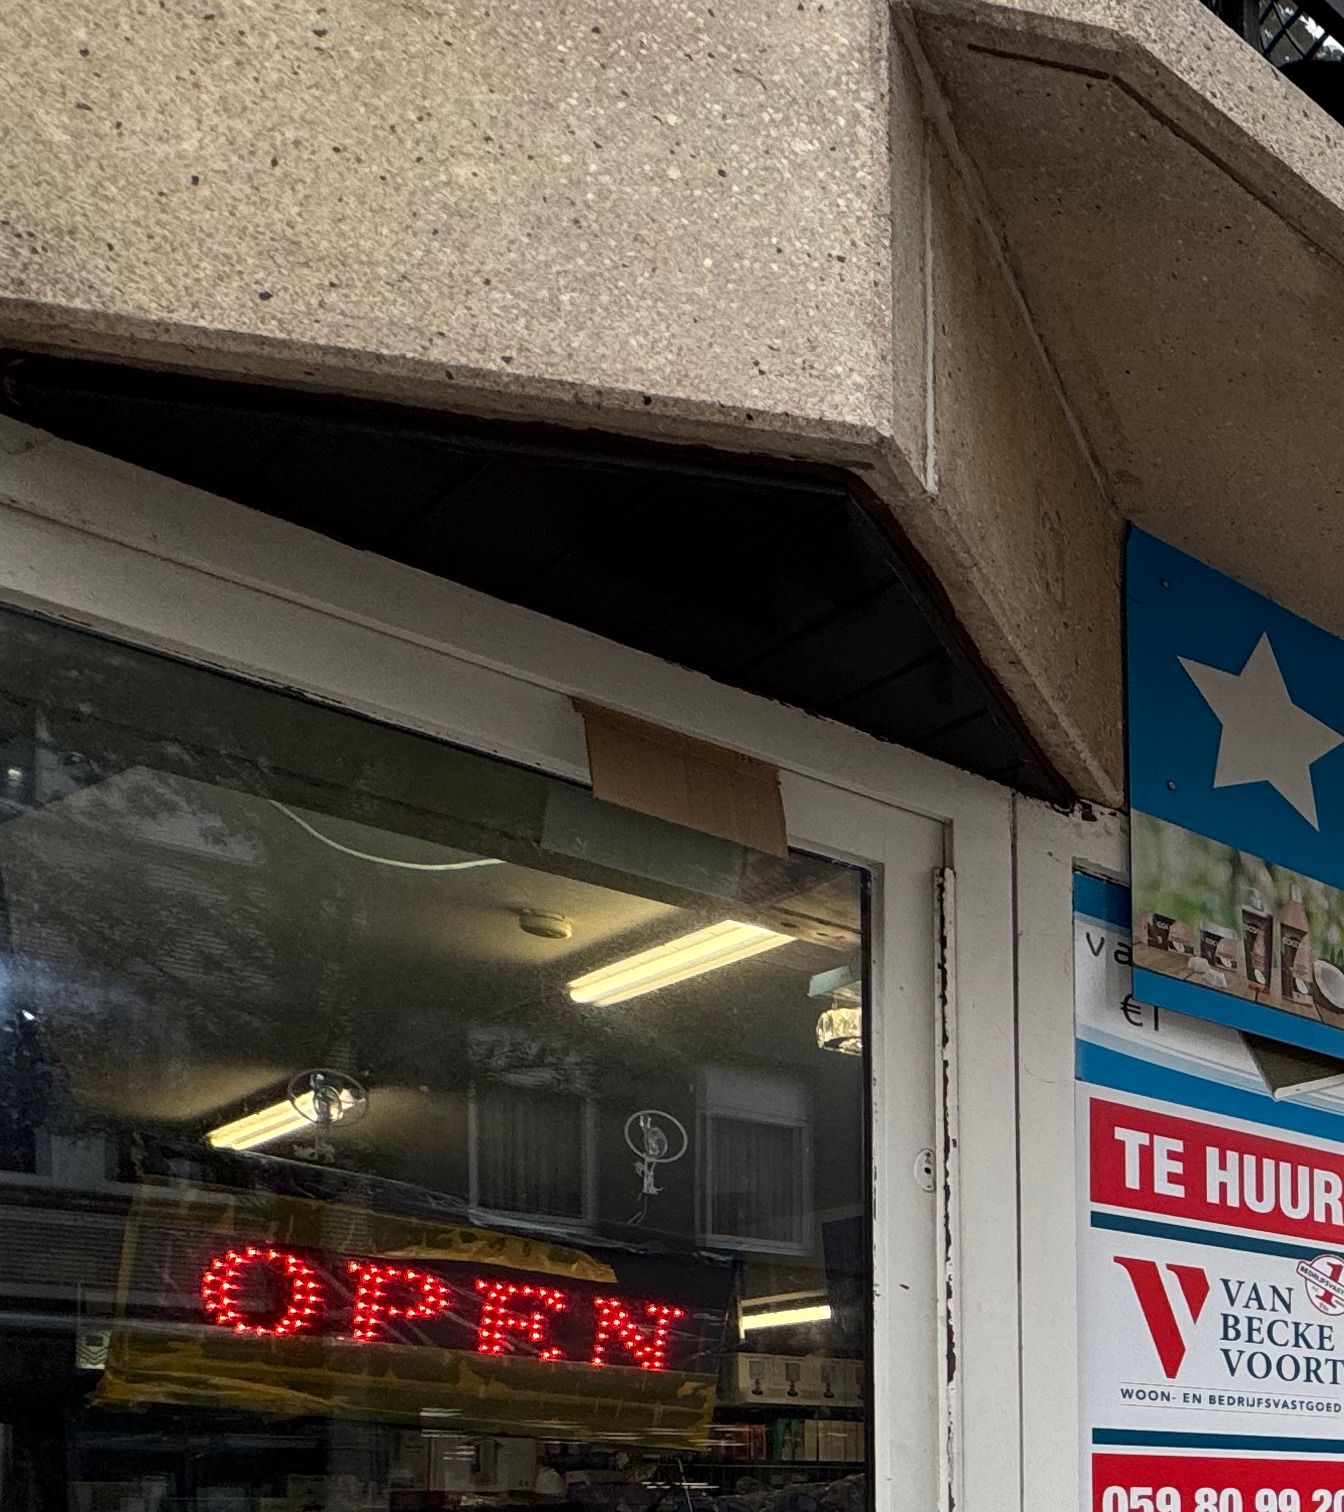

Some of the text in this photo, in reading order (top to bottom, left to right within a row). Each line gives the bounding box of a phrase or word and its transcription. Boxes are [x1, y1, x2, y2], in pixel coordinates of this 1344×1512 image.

[1114, 1126, 1344, 1227] TE HUUR
[201, 1243, 686, 1373] OPEN
[1219, 1277, 1294, 1315] VAN
[1220, 1312, 1336, 1352] BECKE
[1221, 1348, 1344, 1385] VOORT
[1120, 1387, 1343, 1414] WOON- EN BEDRIJFSVASTGOED
